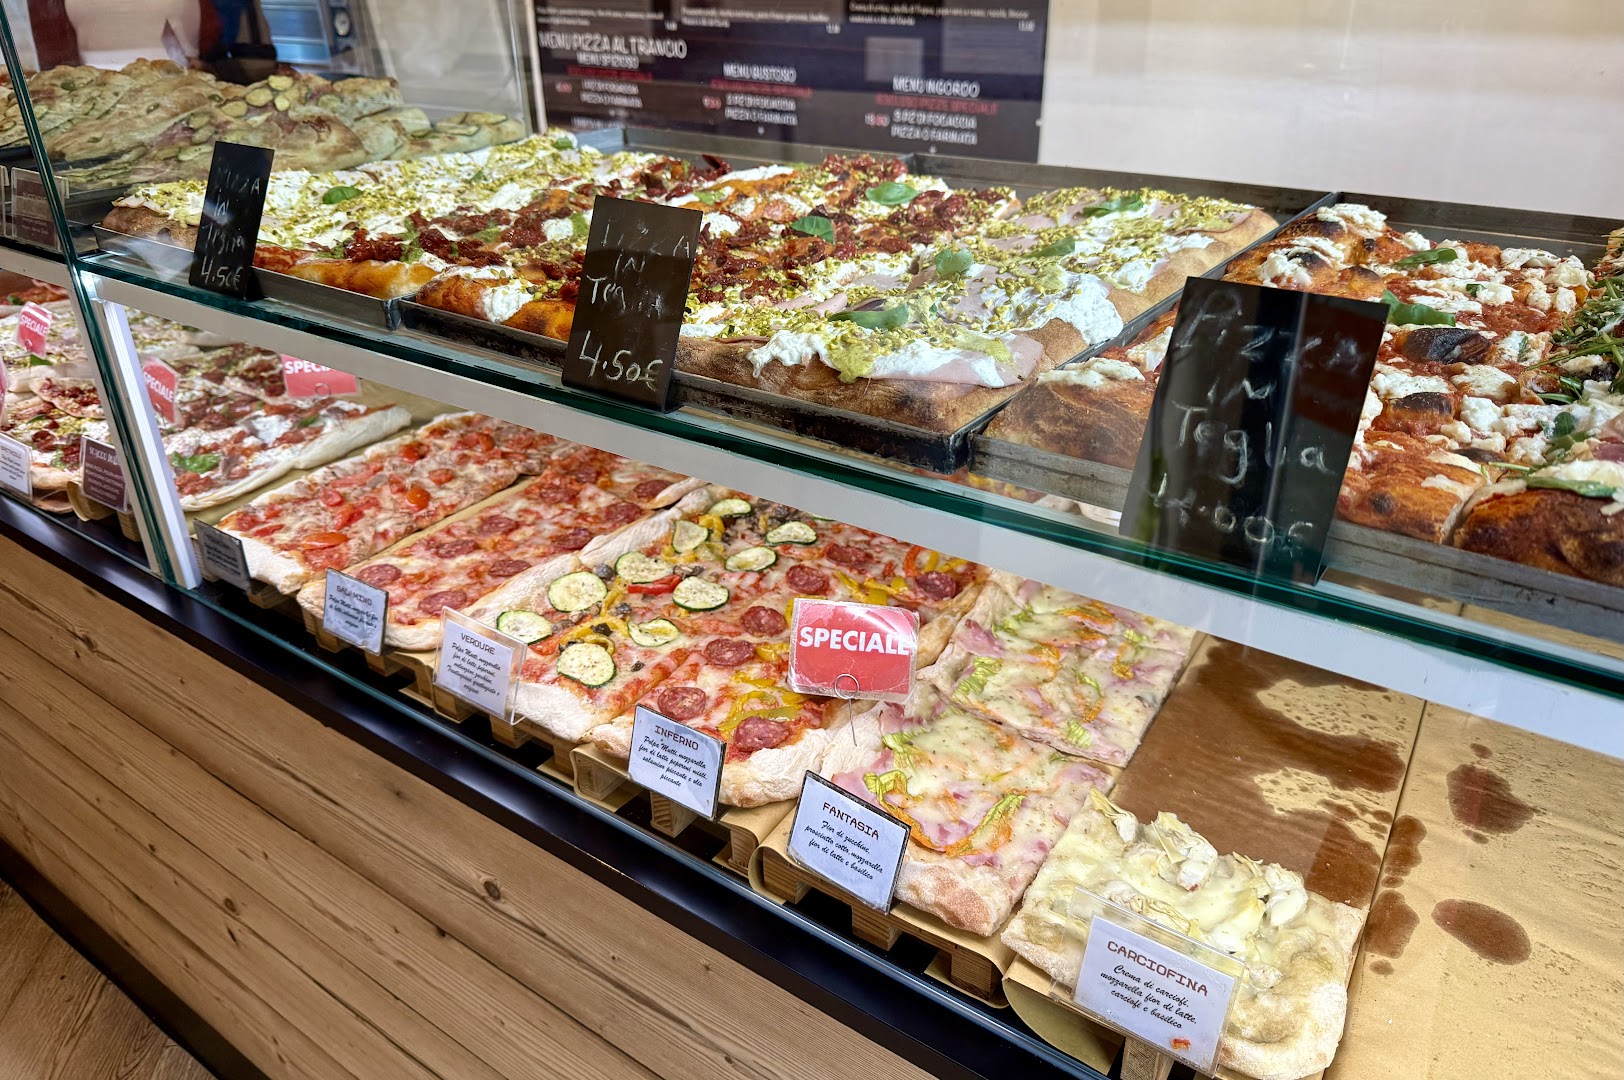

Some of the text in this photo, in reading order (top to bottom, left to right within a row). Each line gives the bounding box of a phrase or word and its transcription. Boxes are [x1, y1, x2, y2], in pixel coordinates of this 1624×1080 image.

[538, 31, 688, 59] MENU PIZZA AL TRANCIO
[723, 61, 797, 83] MENU GUSTOSO
[893, 75, 925, 94] MENU
[20, 313, 49, 337] SPECIALE
[579, 330, 664, 392] 4.50€
[460, 632, 496, 655] VERDURE
[799, 626, 911, 656] SPECIALE
[644, 735, 659, 748] Polpa
[679, 753, 706, 769] mozzarella
[654, 725, 699, 751] INFERNO
[638, 744, 649, 753] fior
[656, 751, 669, 762] latte
[669, 759, 692, 772] peperoni
[642, 756, 665, 770] salamino
[666, 765, 687, 779] piccante
[692, 778, 703, 787] olio
[660, 774, 682, 787] piccante
[821, 820, 835, 834] Fior
[836, 829, 844, 838] di
[822, 801, 880, 841] FANTASIA
[804, 825, 883, 874] prosciutto cotto, mozzarella
[808, 838, 821, 849] fior
[821, 845, 829, 854] di
[829, 849, 844, 863] latte
[850, 862, 874, 880] basilico
[1107, 940, 1209, 997] CARCIOFINA
[1100, 971, 1197, 1025] mozzarella fior di latte,
[1113, 965, 1190, 1008] Crema di carciofi,
[1110, 988, 1142, 1009] carciofi
[1150, 1008, 1183, 1030] basilico
